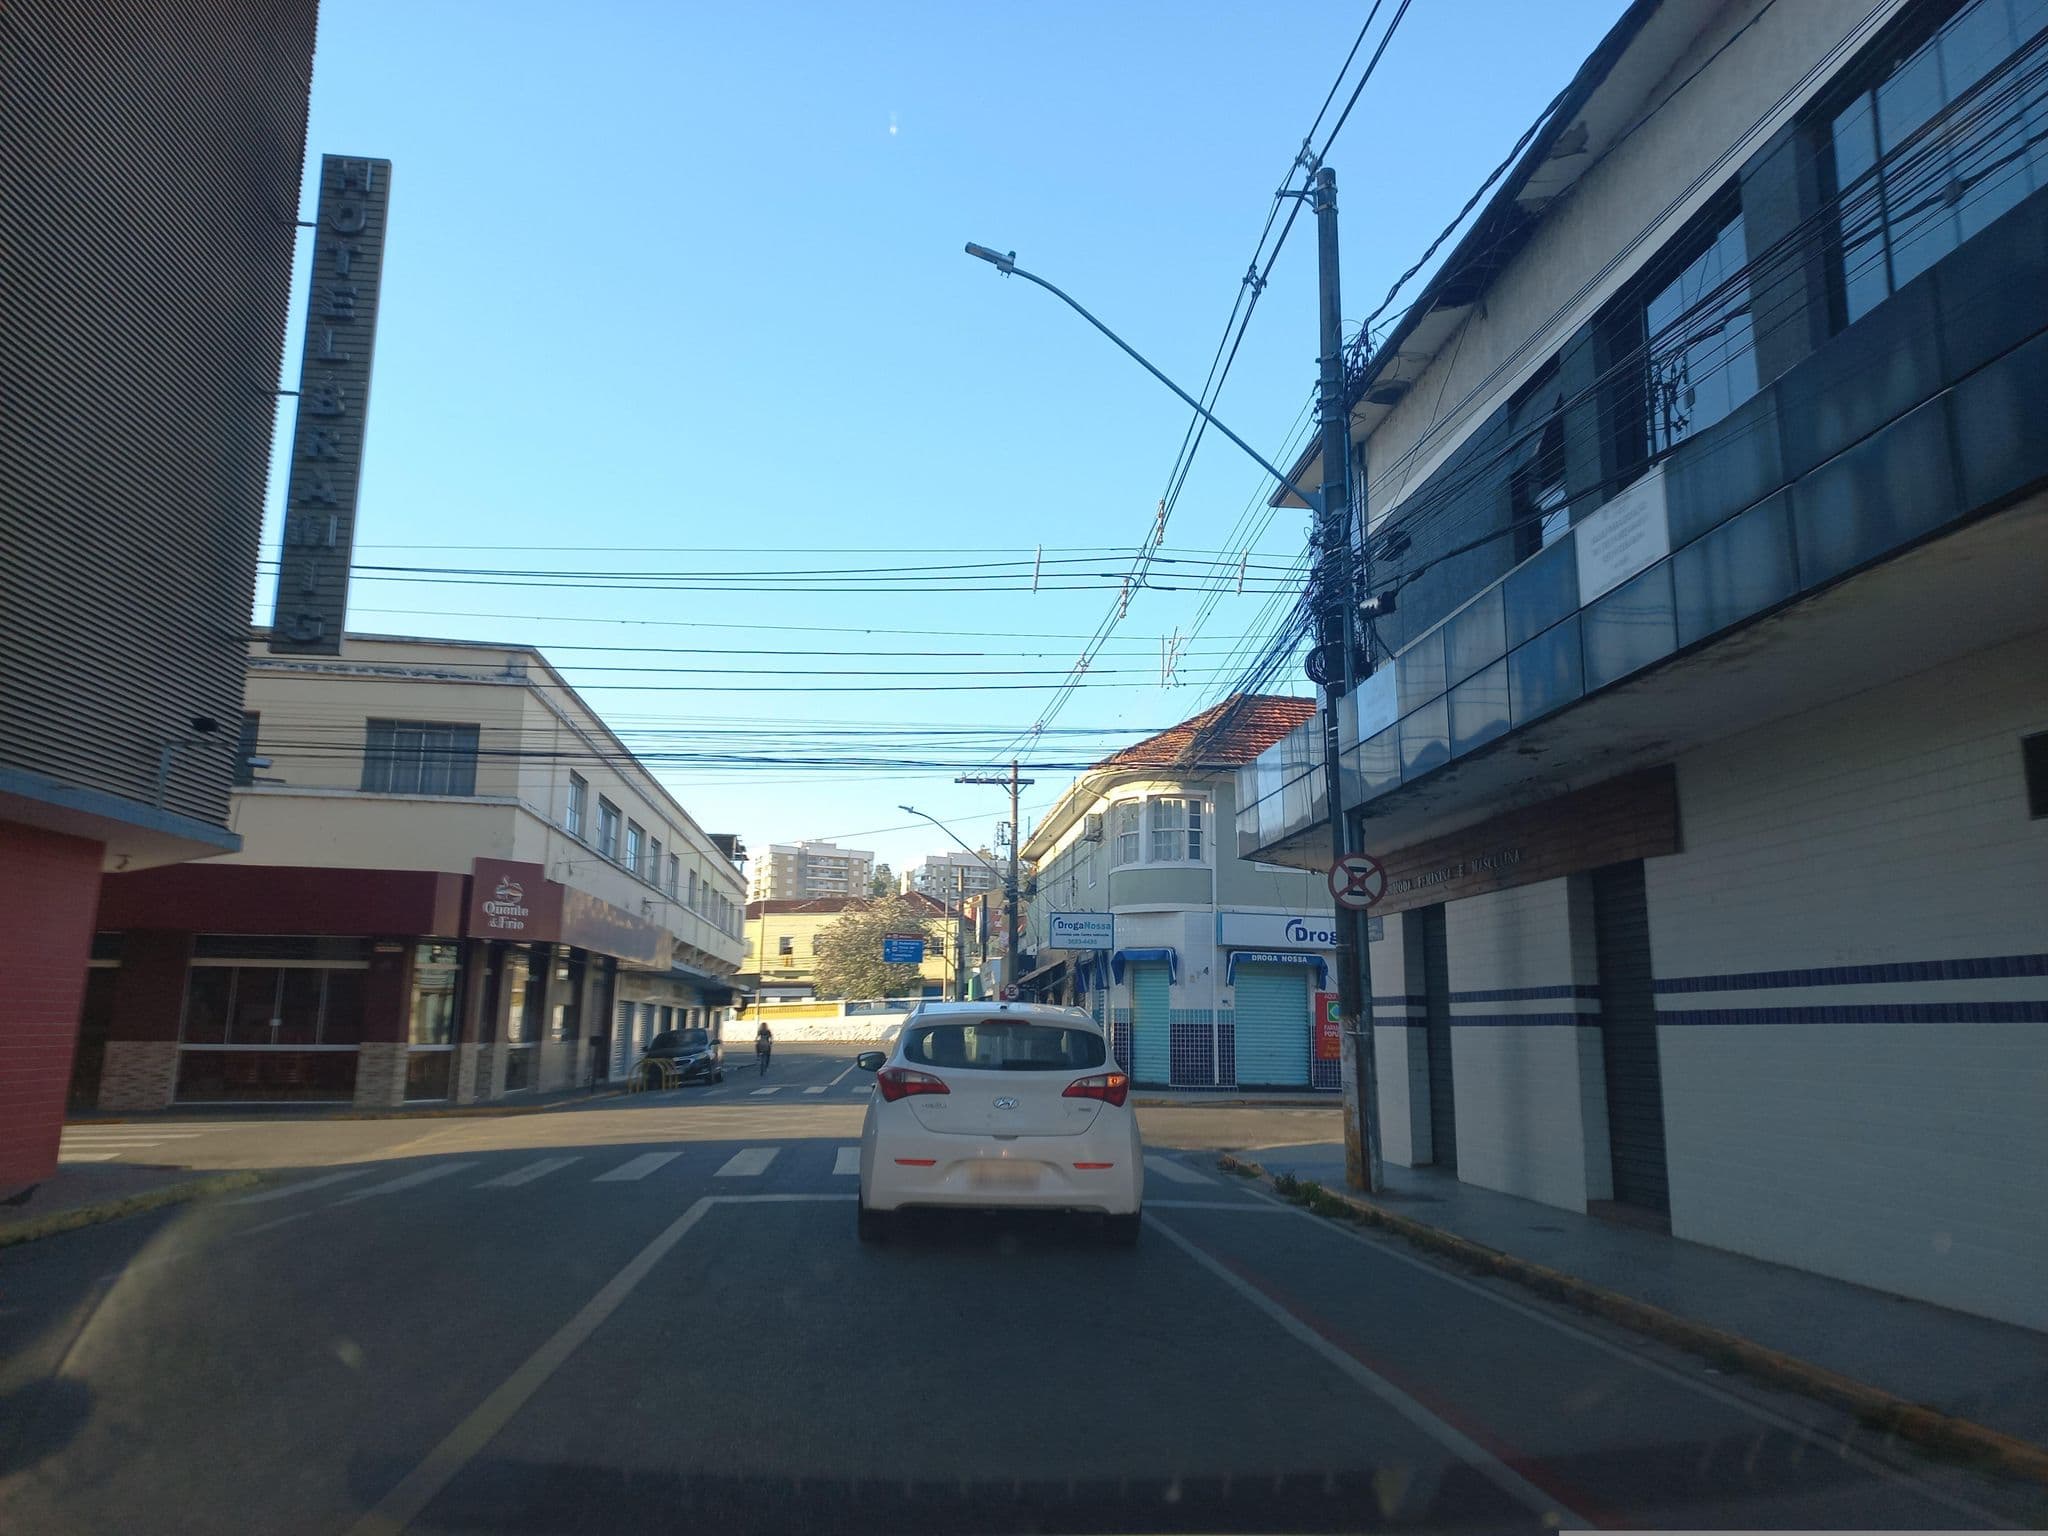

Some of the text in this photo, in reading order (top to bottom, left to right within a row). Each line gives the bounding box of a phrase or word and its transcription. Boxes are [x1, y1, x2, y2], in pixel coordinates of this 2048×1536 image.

[317, 159, 373, 360] HOTEL
[1471, 849, 1521, 873] MASCULINA
[482, 901, 529, 916] Quente
[1057, 920, 1111, 931] DrogaNossa
[1251, 954, 1308, 963] DROGA NOSSA
